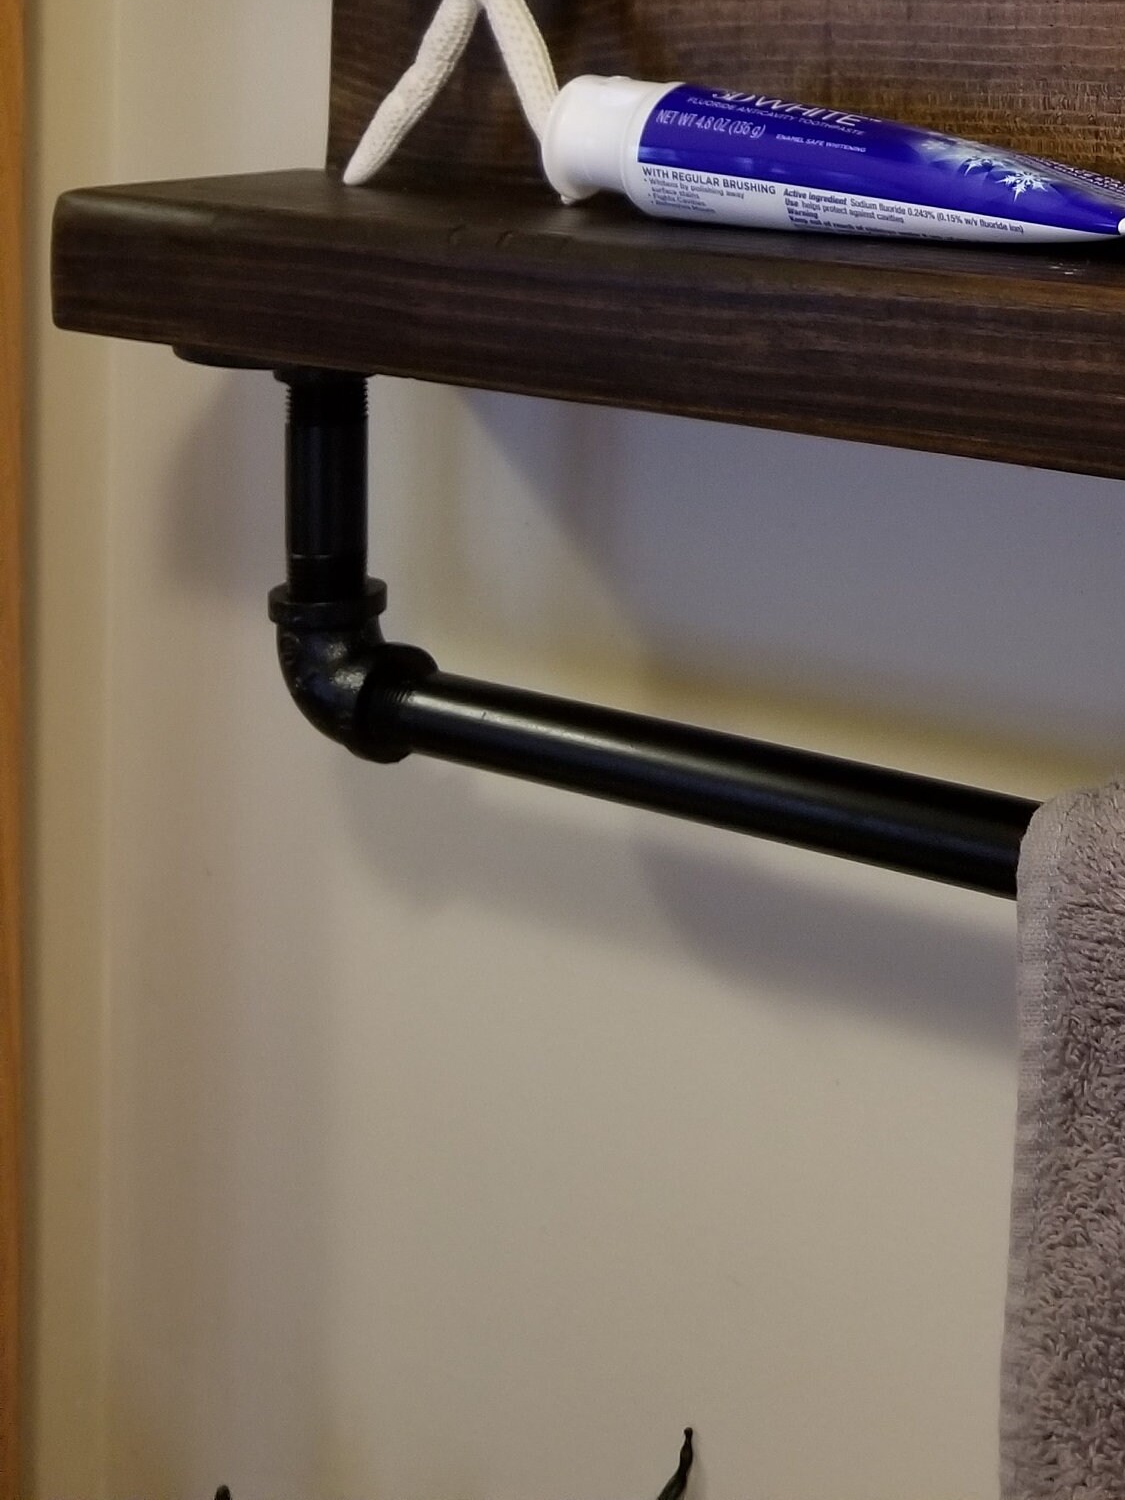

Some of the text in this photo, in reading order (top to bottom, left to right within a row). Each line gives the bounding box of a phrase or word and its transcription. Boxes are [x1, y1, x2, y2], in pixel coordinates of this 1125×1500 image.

[656, 109, 677, 125] NET
[678, 112, 696, 127] WT
[696, 115, 712, 129] 4.8
[712, 117, 730, 132] OZ
[750, 124, 766, 139] g)
[688, 97, 866, 136] FLUORIDE ANTICAVITY TOOTHPASTE
[776, 133, 867, 153] ENAMEL SAFE WHITENING
[642, 166, 777, 195] WITH REGULAR BRUSHING
[783, 188, 807, 200] Active
[850, 198, 877, 210] Sodium
[907, 208, 935, 220] 0.243%
[937, 212, 963, 224] (0.15%
[785, 198, 799, 207] Use
